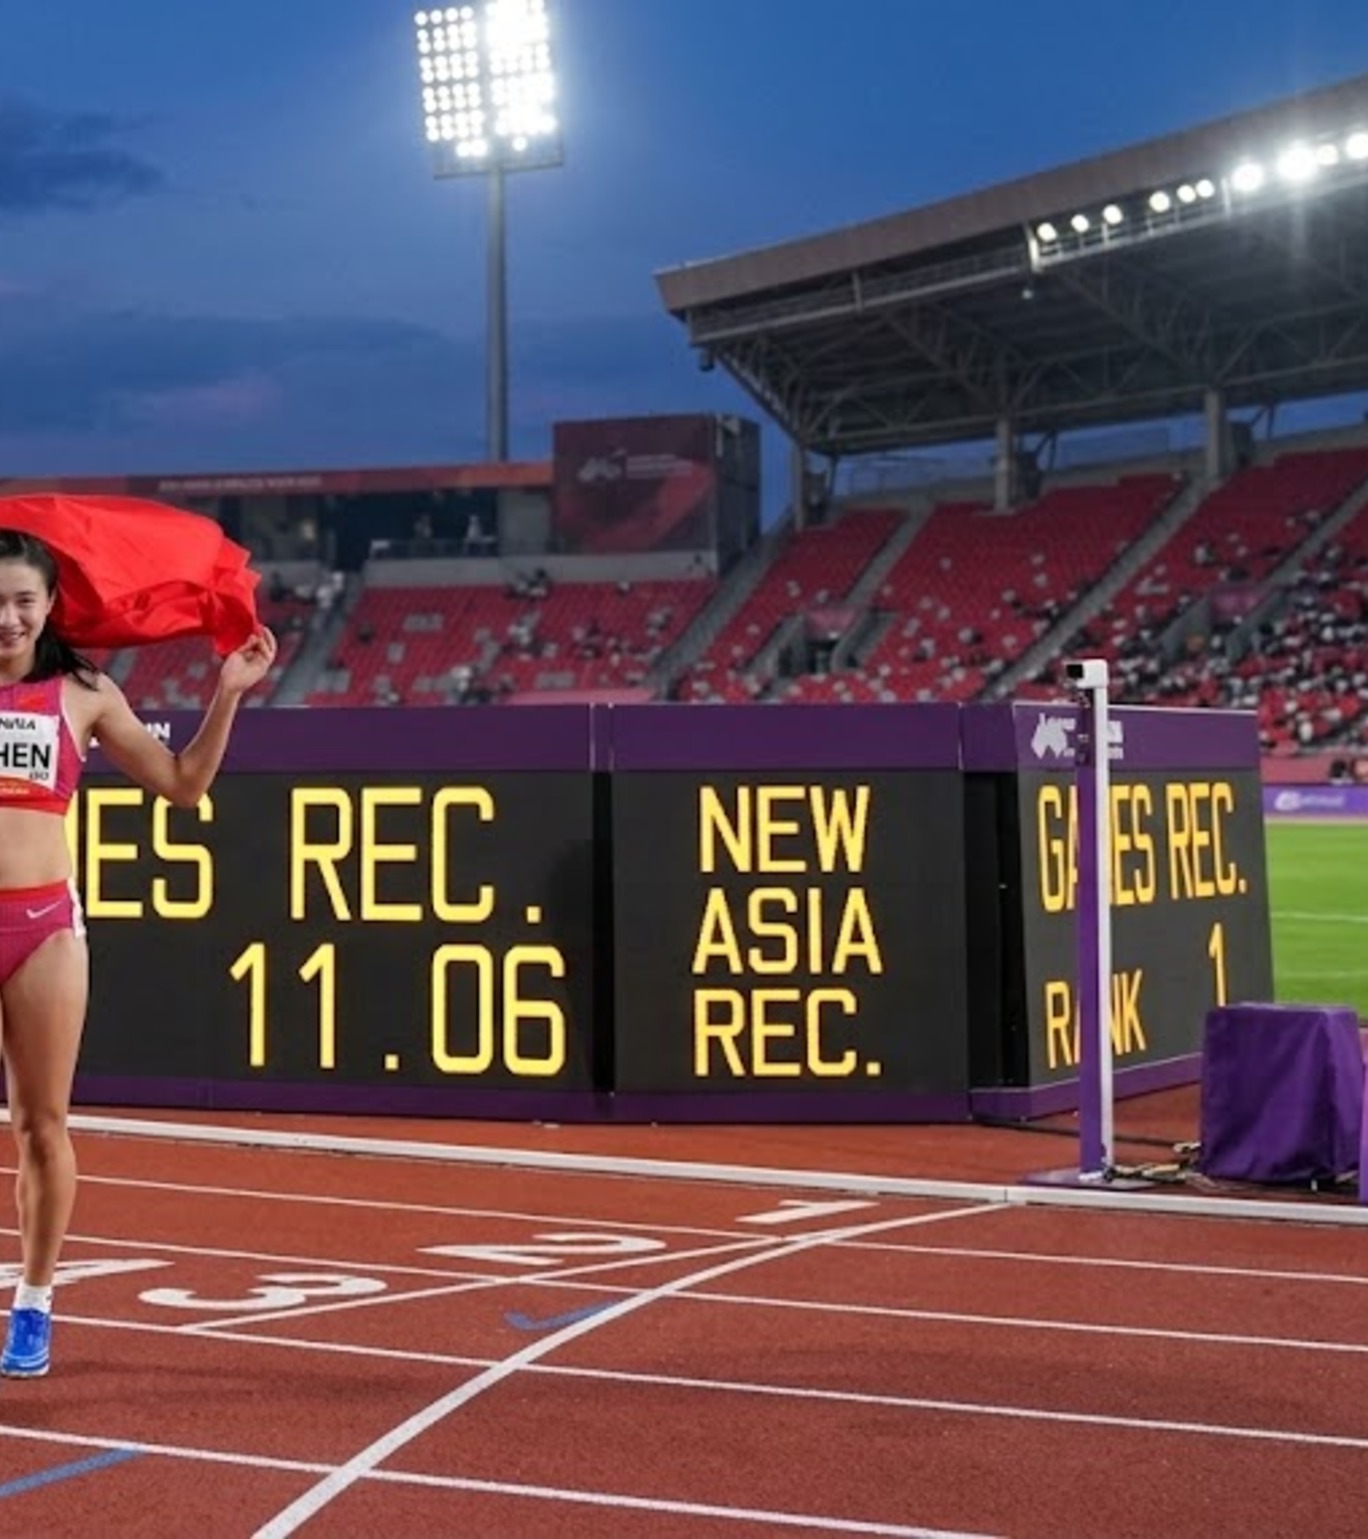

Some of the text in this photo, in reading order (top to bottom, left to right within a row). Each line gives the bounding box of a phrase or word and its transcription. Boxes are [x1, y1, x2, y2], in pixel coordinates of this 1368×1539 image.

[291, 787, 541, 923] REC.
[700, 785, 871, 873] NEW
[1038, 782, 1247, 913] GES REC.
[692, 887, 882, 975] ASIA
[1208, 922, 1226, 1007] 1
[230, 943, 566, 1076] 11.06
[694, 988, 882, 1077] REC.
[1045, 968, 1147, 1069] RNK
[417, 1232, 667, 1266] 2
[736, 1200, 880, 1224] 1
[138, 1272, 387, 1310] 3
